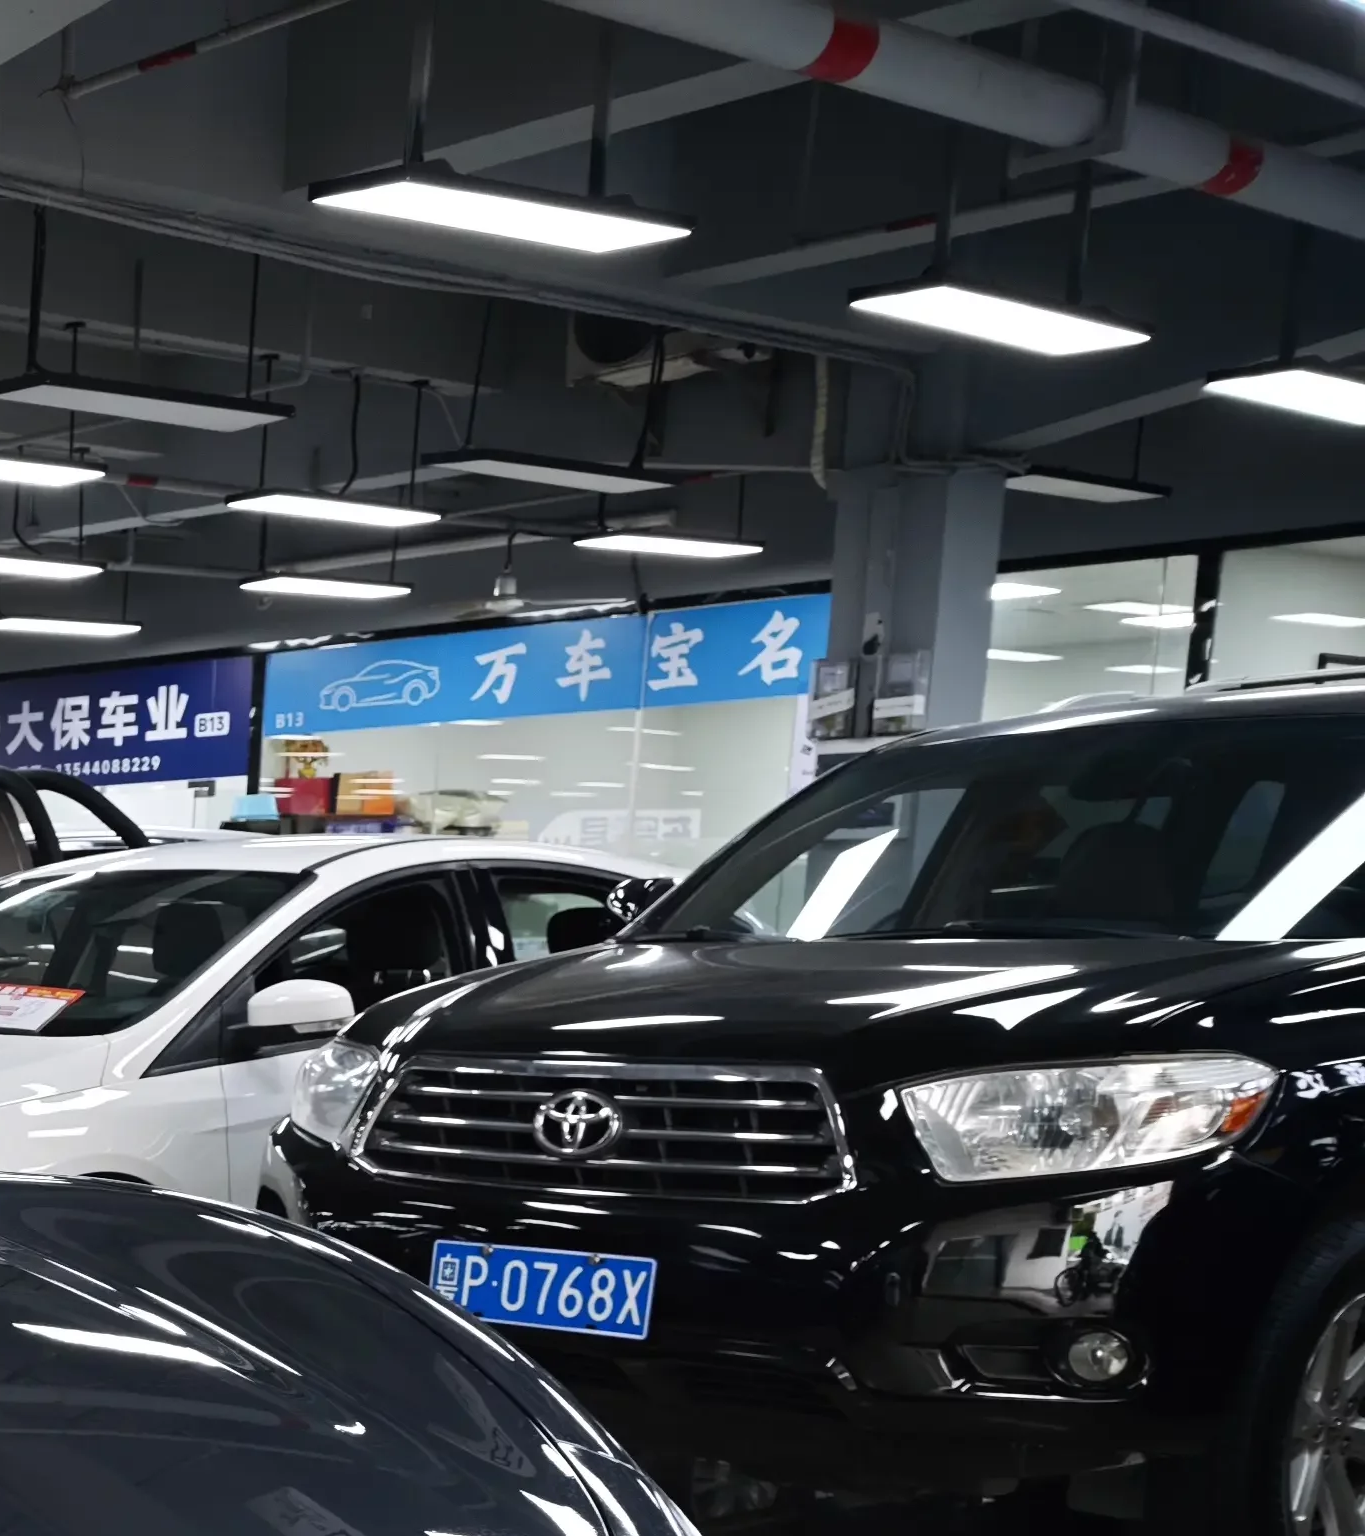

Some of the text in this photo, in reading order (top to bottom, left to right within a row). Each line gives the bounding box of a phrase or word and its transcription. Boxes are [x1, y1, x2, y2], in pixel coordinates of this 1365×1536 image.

[5, 684, 190, 756] 大保车业
[198, 715, 225, 733] B13
[275, 712, 304, 729] B13
